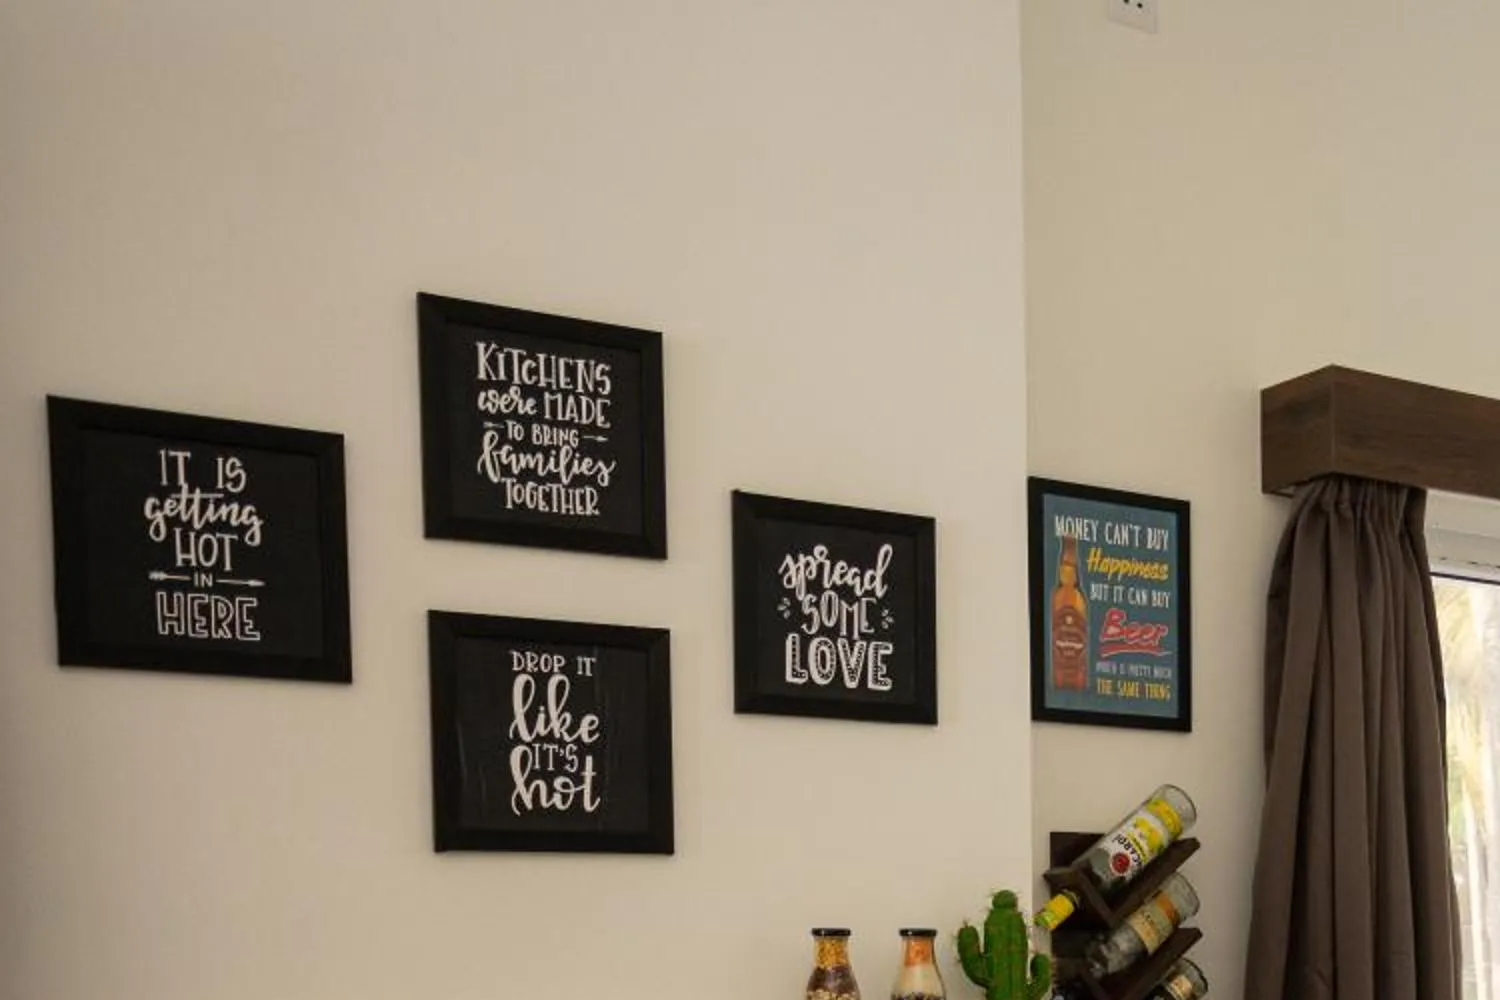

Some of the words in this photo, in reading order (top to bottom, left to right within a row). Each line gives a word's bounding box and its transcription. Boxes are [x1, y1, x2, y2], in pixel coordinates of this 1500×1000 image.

[475, 341, 612, 395] KITCHENS
[477, 386, 538, 415] were
[543, 391, 611, 429] MADE
[504, 420, 525, 441] TO
[531, 423, 580, 448] BRING
[159, 449, 192, 486] IT
[216, 456, 247, 493] IS
[477, 430, 617, 487] families
[144, 483, 264, 547] getting
[500, 477, 600, 516] TOGETHER
[174, 527, 239, 571] HOT
[1054, 514, 1099, 543] MONEY
[1104, 520, 1141, 548] CAN'T
[1146, 527, 1169, 551] BUY
[194, 571, 214, 588] IN
[777, 543, 893, 601] spread
[1086, 547, 1169, 582] Happiness
[156, 591, 261, 641] HERE
[801, 590, 877, 641] SOME
[1090, 582, 1109, 602] BUT
[1113, 585, 1125, 604] IT
[1128, 586, 1148, 606] CAN
[1151, 589, 1171, 609] BUY
[1099, 607, 1168, 646] Beer
[511, 650, 566, 673] DROP
[576, 656, 597, 677] IT
[785, 633, 893, 691] LOVE
[509, 673, 600, 743] like
[509, 744, 601, 816] hot
[532, 743, 579, 773] IT'S
